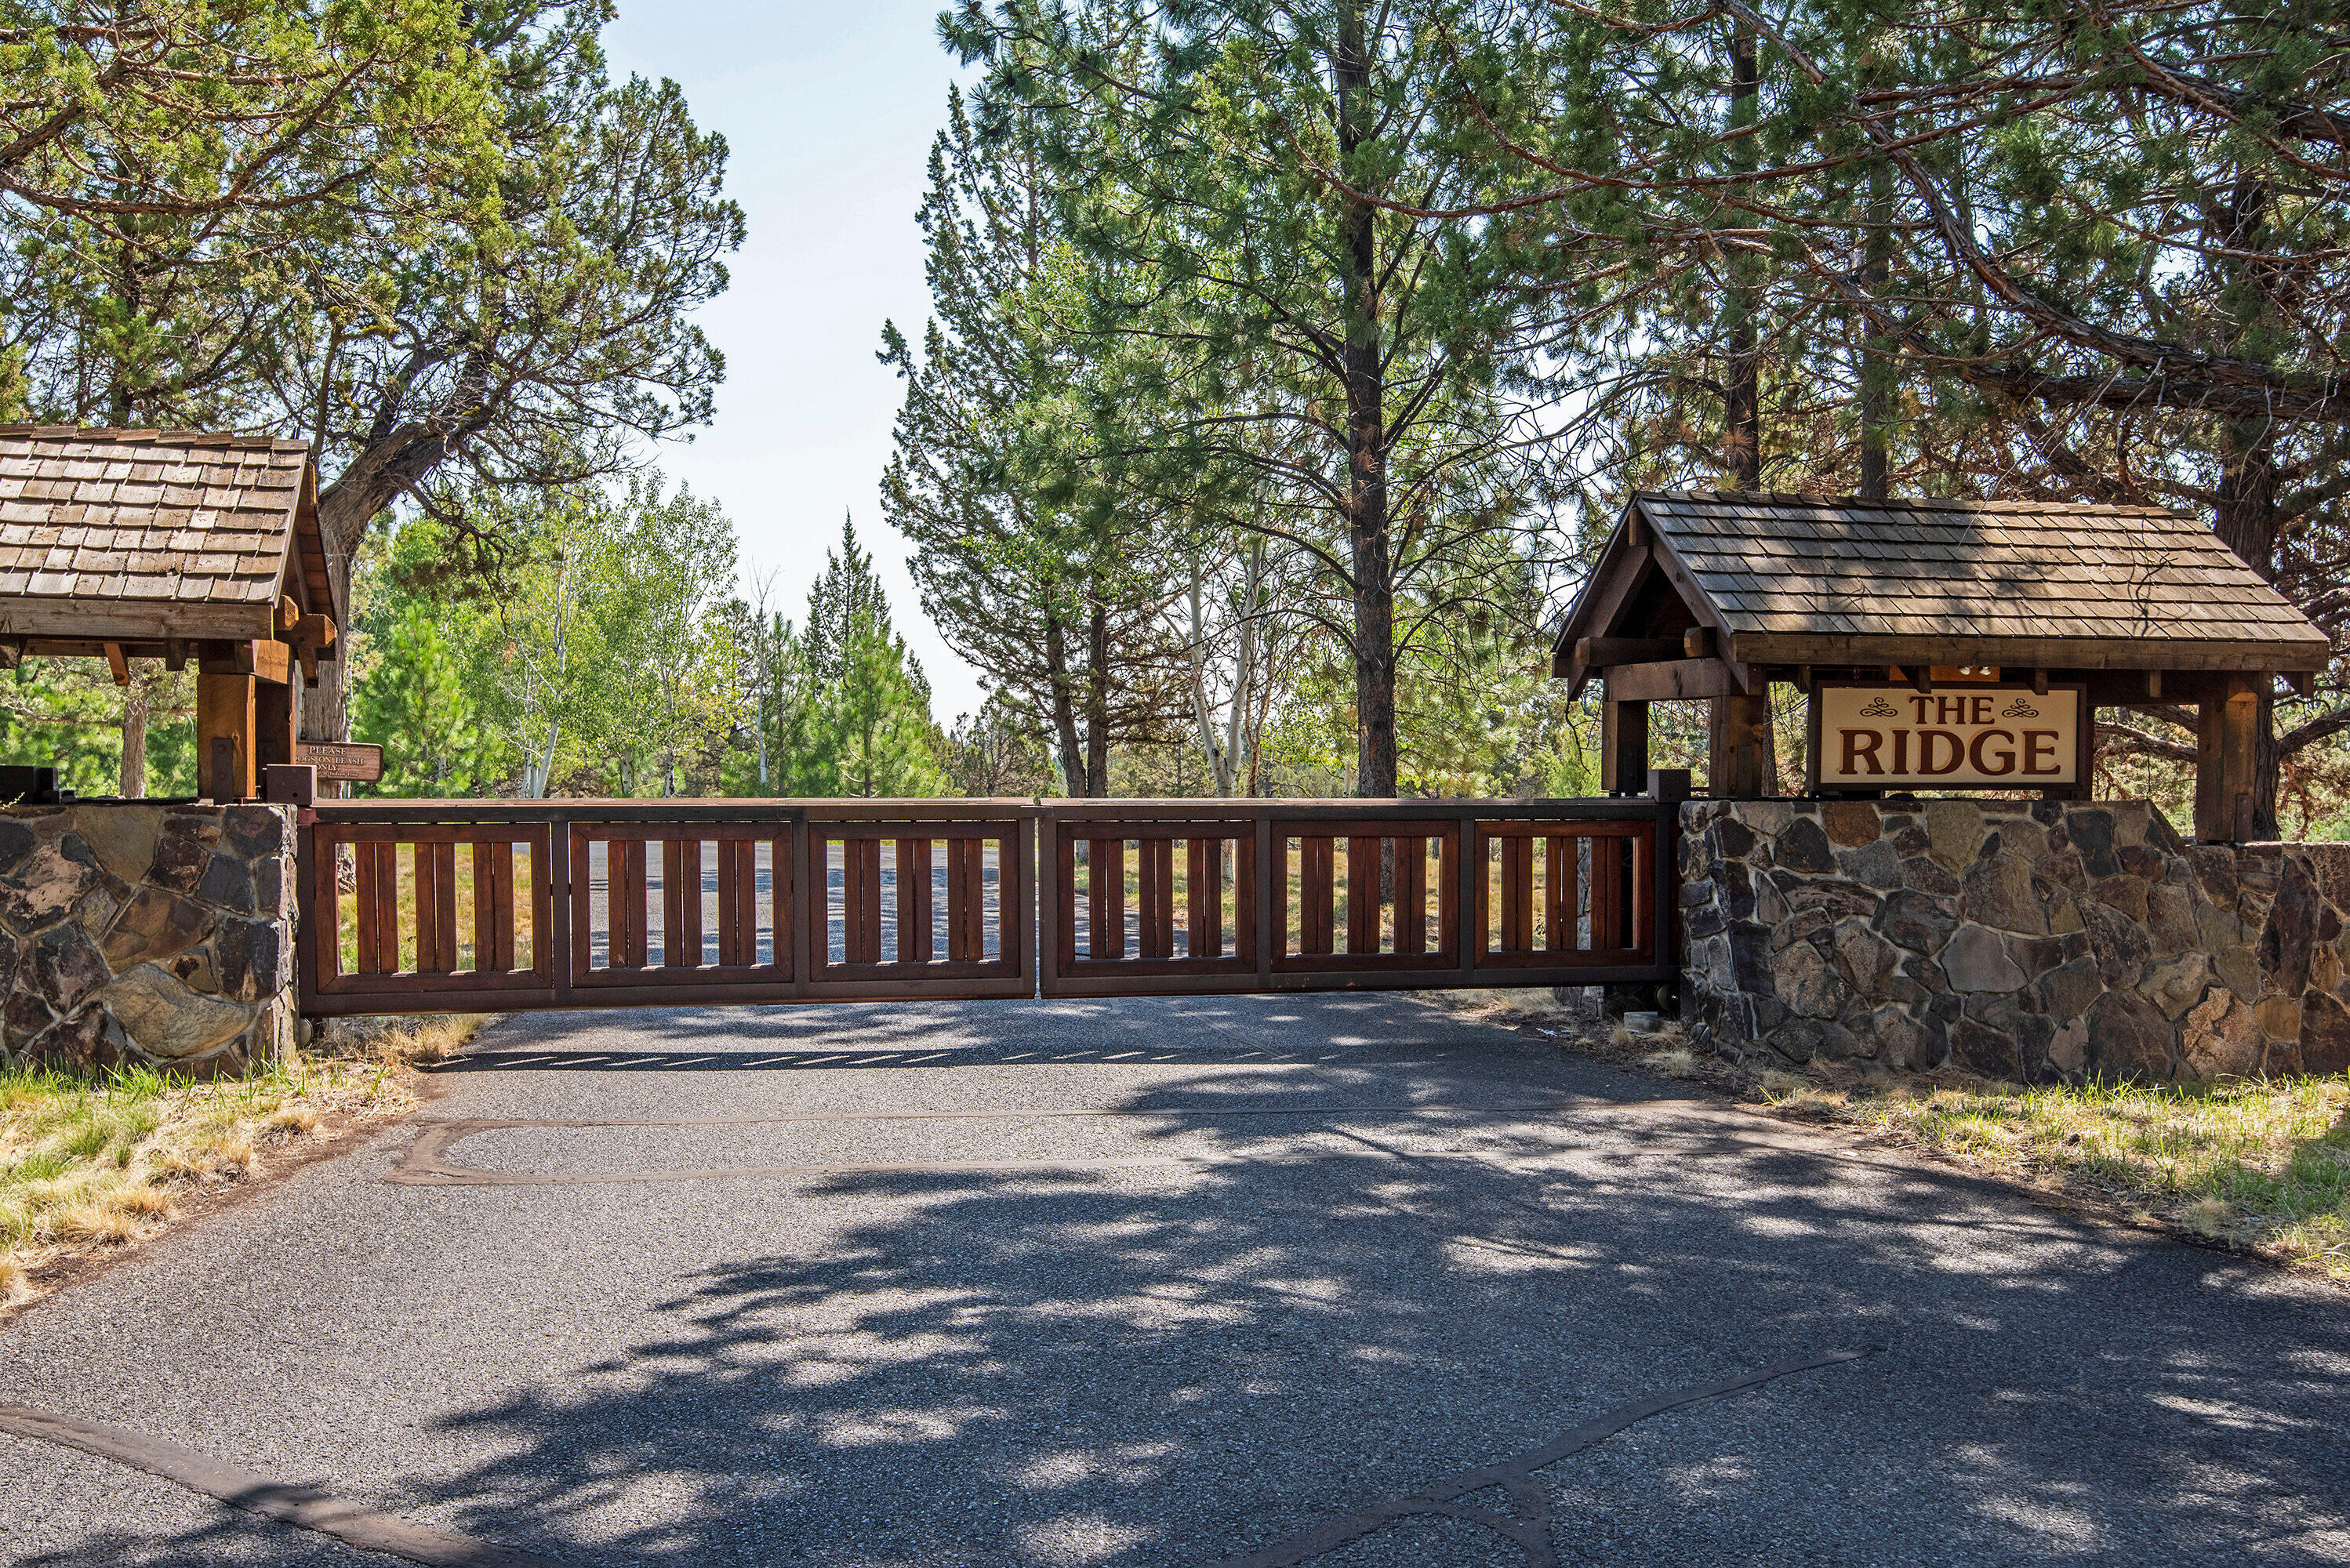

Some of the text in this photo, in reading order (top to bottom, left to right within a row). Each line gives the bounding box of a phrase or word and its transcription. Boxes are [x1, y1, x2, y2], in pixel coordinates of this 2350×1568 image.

[1908, 695, 1995, 724] THE
[309, 746, 347, 755] PLEASE
[1837, 728, 2061, 776] RIDGE
